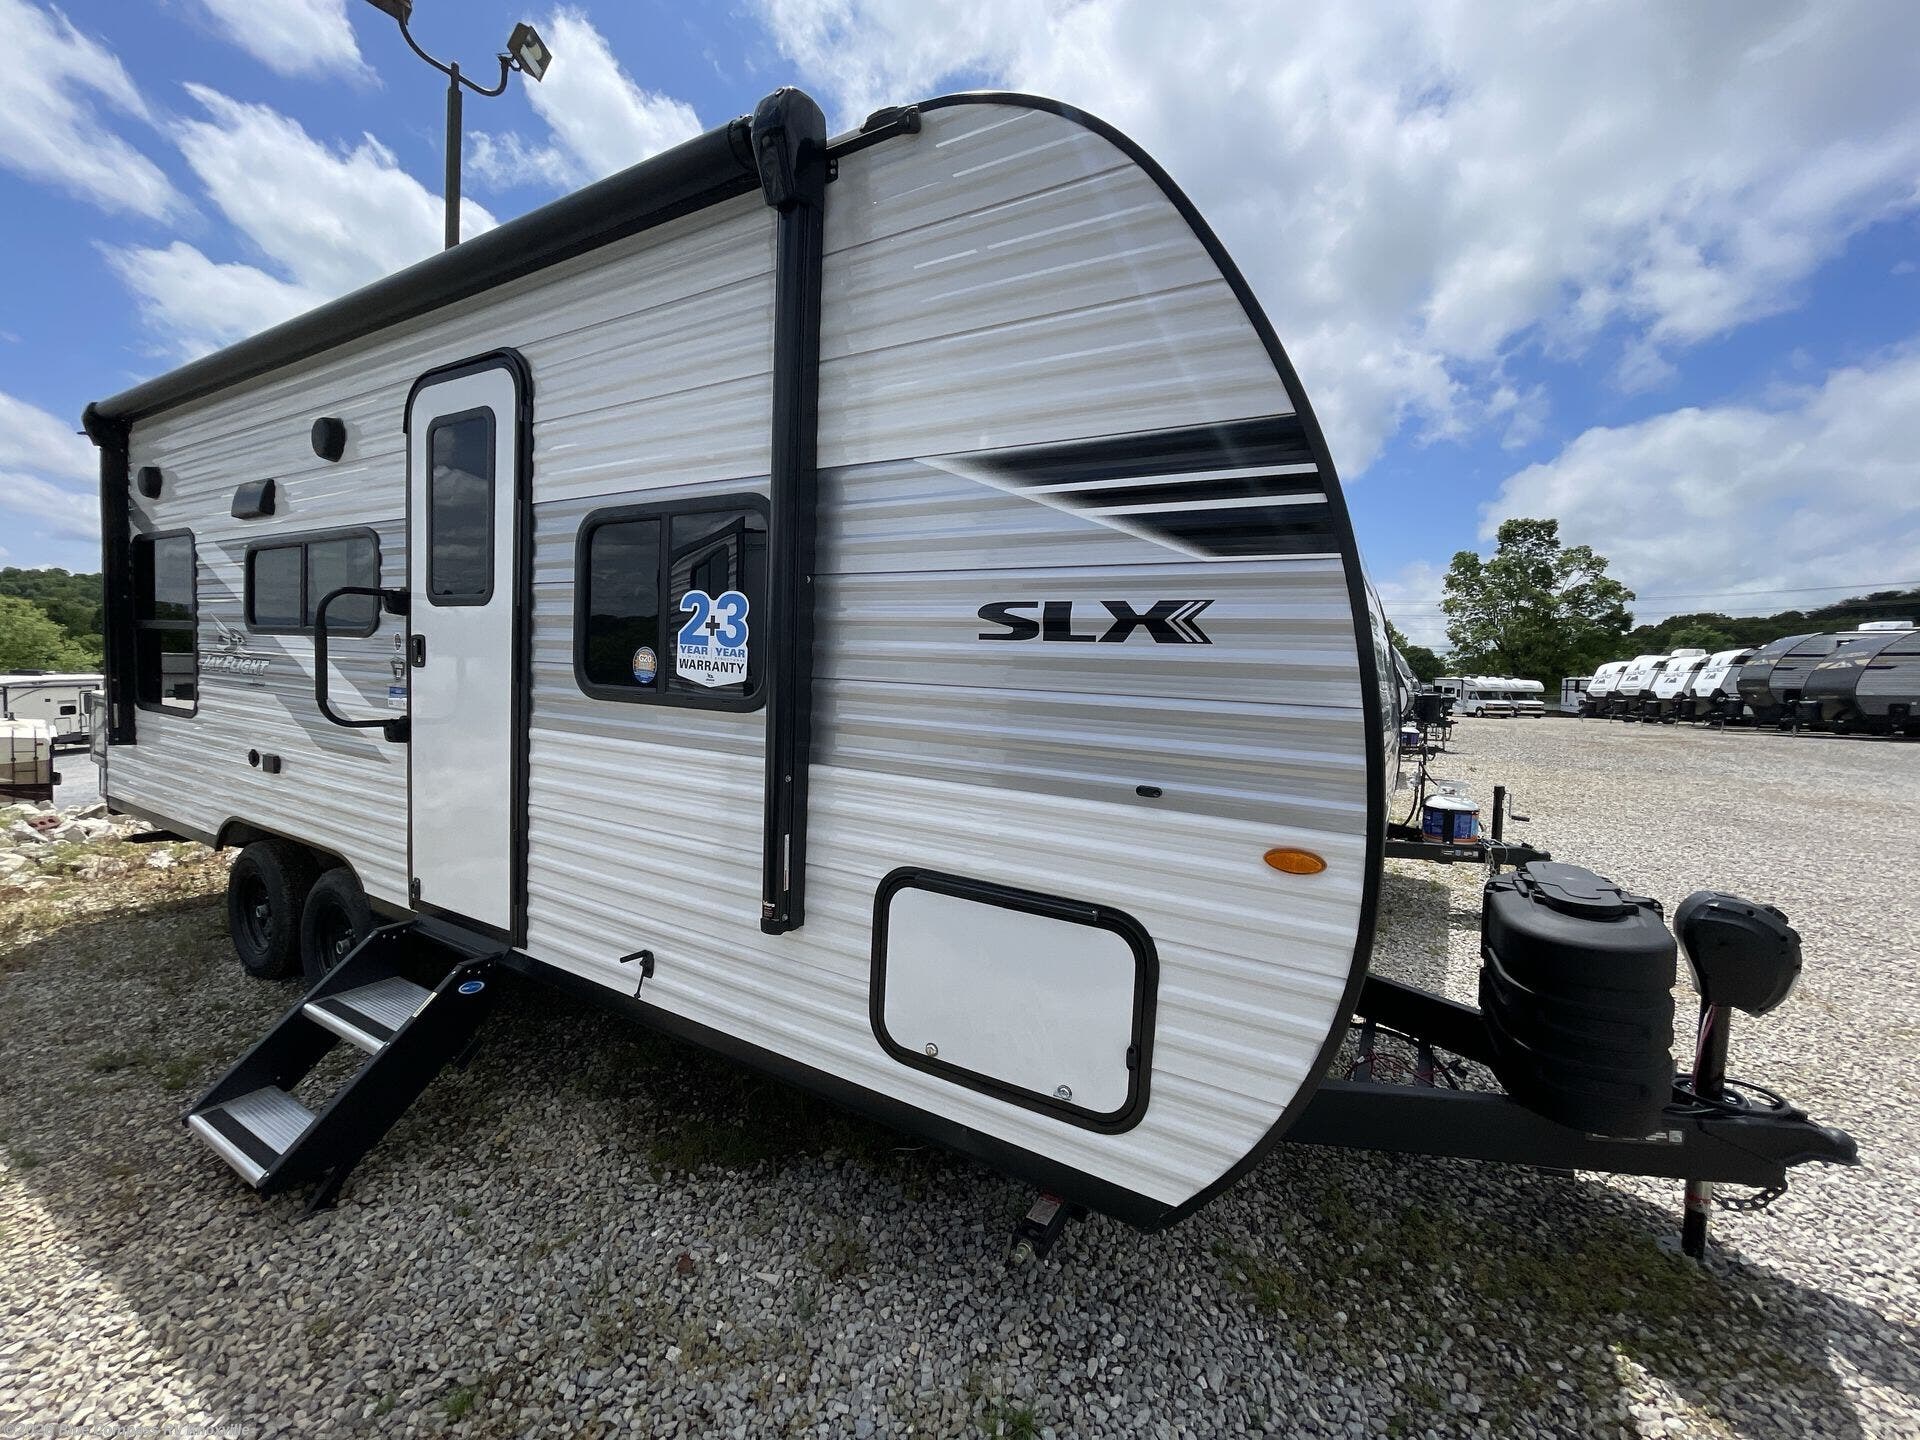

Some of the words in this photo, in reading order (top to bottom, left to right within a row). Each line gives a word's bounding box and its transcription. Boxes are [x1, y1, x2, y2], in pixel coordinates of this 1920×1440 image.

[977, 600, 1216, 645] SLX
[680, 645, 708, 655] YEAR
[715, 647, 745, 658] YEAR
[679, 658, 745, 674] WARRANTY
